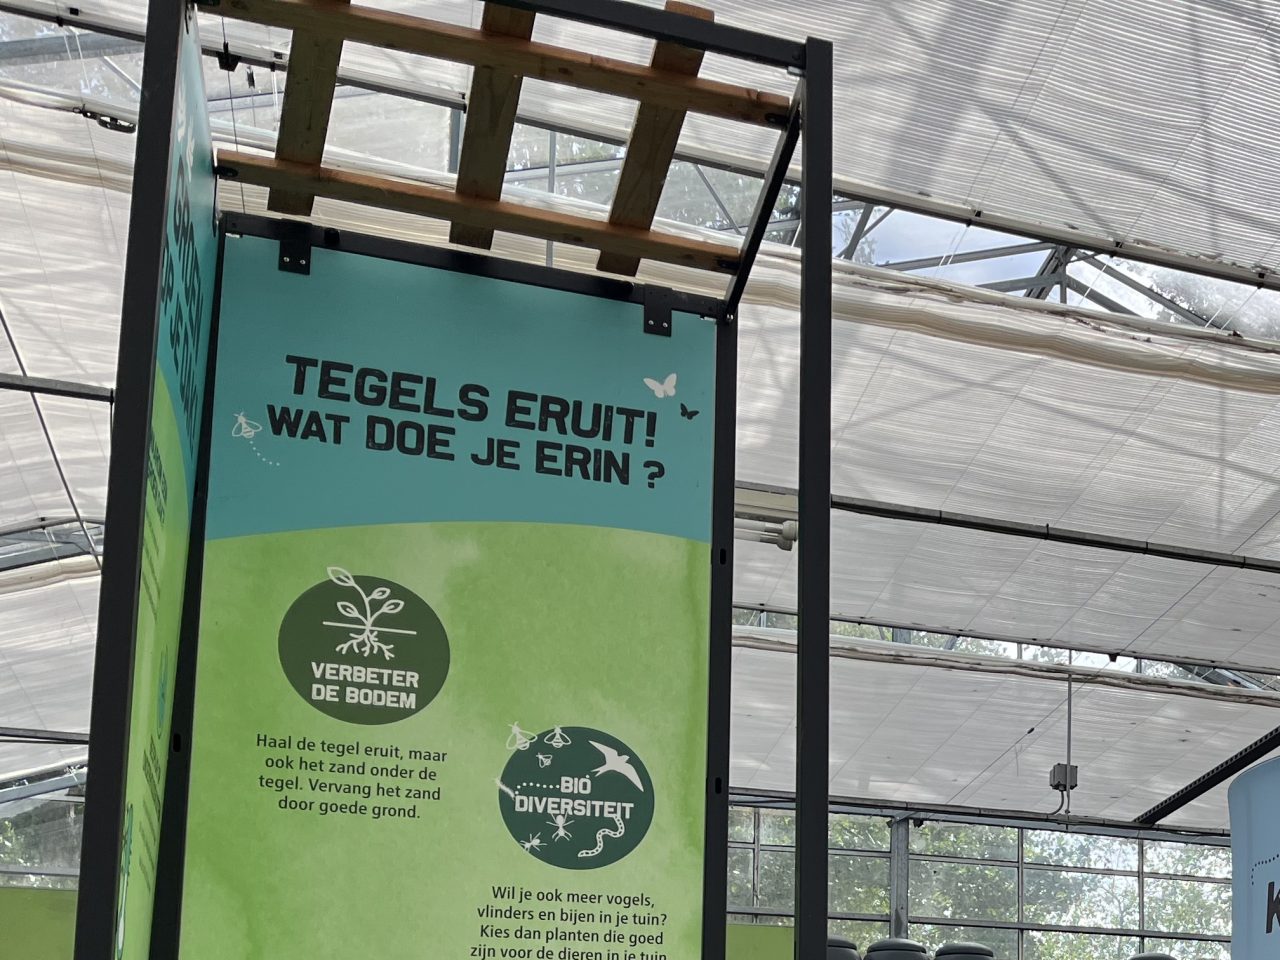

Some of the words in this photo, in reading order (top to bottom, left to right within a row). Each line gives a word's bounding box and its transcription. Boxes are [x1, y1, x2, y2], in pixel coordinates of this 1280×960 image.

[285, 355, 490, 423] TEGELS
[505, 390, 658, 447] ERUIT!
[266, 404, 350, 445] WAT
[365, 415, 455, 461] DOE
[470, 437, 520, 470] JE
[535, 440, 630, 486] ERIN
[311, 661, 420, 688] VERBETER
[311, 683, 340, 702] DE
[345, 687, 417, 709] BODEM
[256, 733, 292, 749] Haal
[296, 737, 316, 751] de
[320, 740, 360, 757] tegel
[364, 745, 404, 760] eruit,
[408, 748, 448, 762] maar
[265, 755, 294, 770] ook
[299, 757, 324, 772] het
[328, 762, 365, 776] zand
[370, 764, 414, 779] onder
[418, 767, 437, 781] de
[258, 775, 303, 792] tegel.
[308, 778, 372, 798] Vervang
[376, 783, 401, 797] het
[405, 787, 441, 801] zand
[560, 776, 592, 794] BIO
[278, 796, 315, 811] door
[319, 800, 367, 815] goede
[372, 805, 420, 819] grond.
[514, 795, 634, 819] DIVERSITEIT
[491, 886, 515, 900] Wil
[519, 887, 532, 903] je
[536, 889, 562, 902] ook
[566, 891, 603, 904] meer
[606, 893, 655, 909] vogels,
[477, 906, 534, 920] vlinders
[538, 909, 556, 921] en
[560, 908, 595, 925] bijen
[599, 911, 612, 923] in
[615, 912, 628, 927] je
[632, 912, 667, 925] tuin?
[480, 925, 510, 938] Kies
[514, 926, 541, 939] dan
[545, 927, 599, 943] planten
[603, 929, 625, 943] die
[629, 932, 664, 946] goed
[470, 944, 496, 960] zijn
[500, 946, 533, 958] voor
[536, 946, 554, 959] de
[558, 947, 602, 960] dieren
